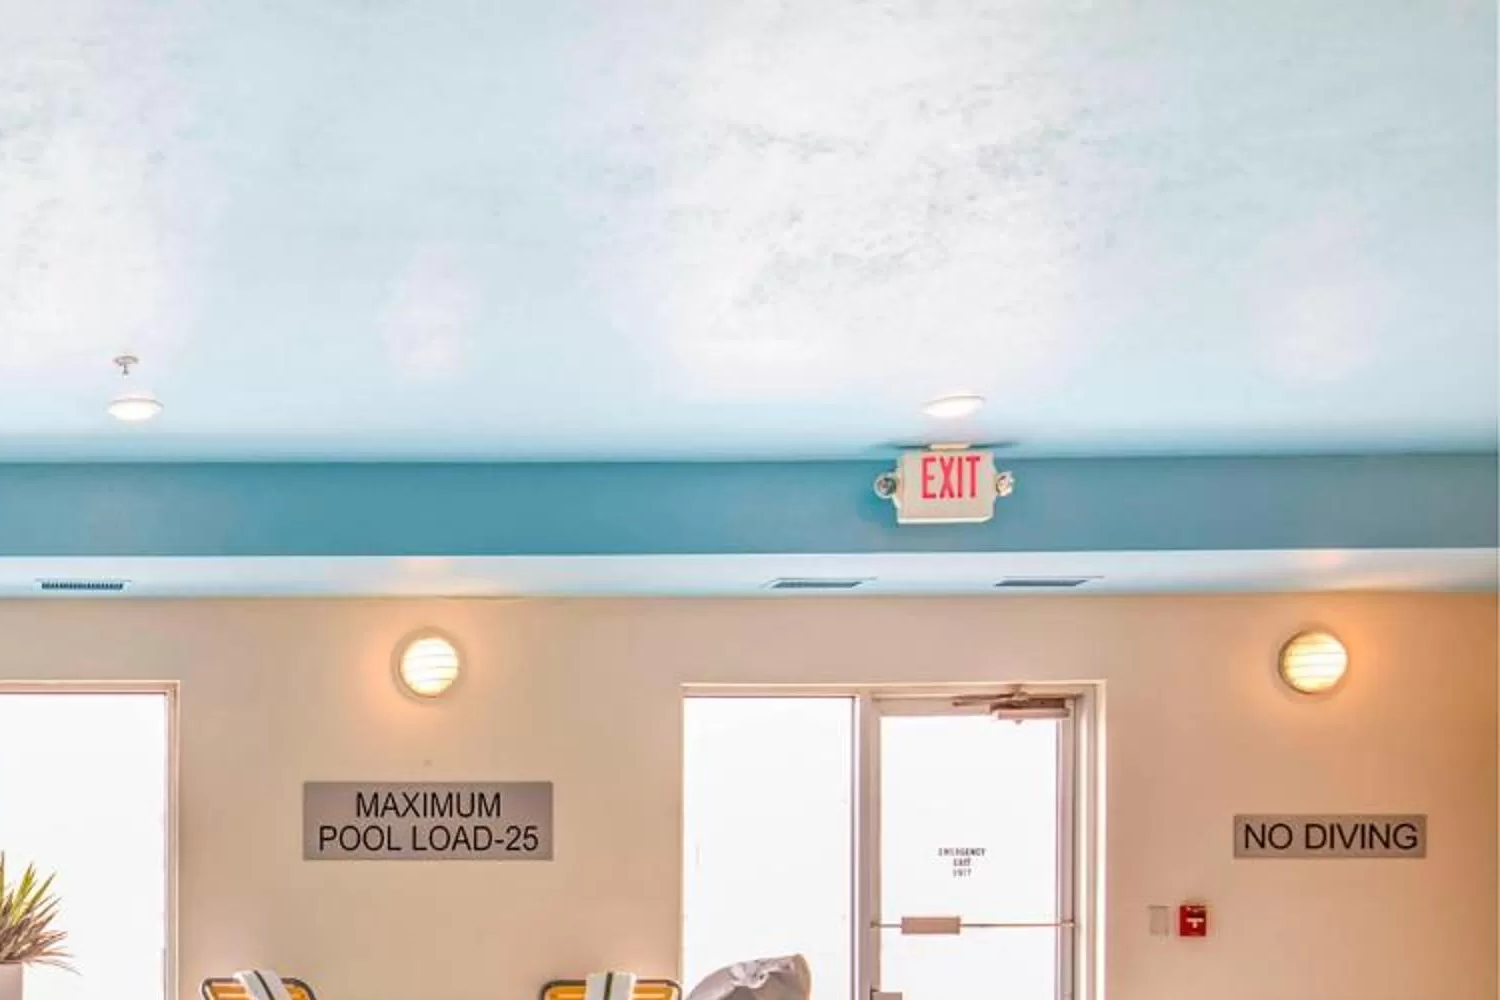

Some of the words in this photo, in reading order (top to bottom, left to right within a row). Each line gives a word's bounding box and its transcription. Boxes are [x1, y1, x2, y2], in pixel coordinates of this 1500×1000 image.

[921, 456, 980, 499] EXIT
[356, 792, 501, 818] MAXIMUM
[319, 825, 401, 851] POOL
[412, 825, 539, 851] LOAD-25
[1244, 822, 1293, 850] NO
[1305, 822, 1418, 850] DIVING
